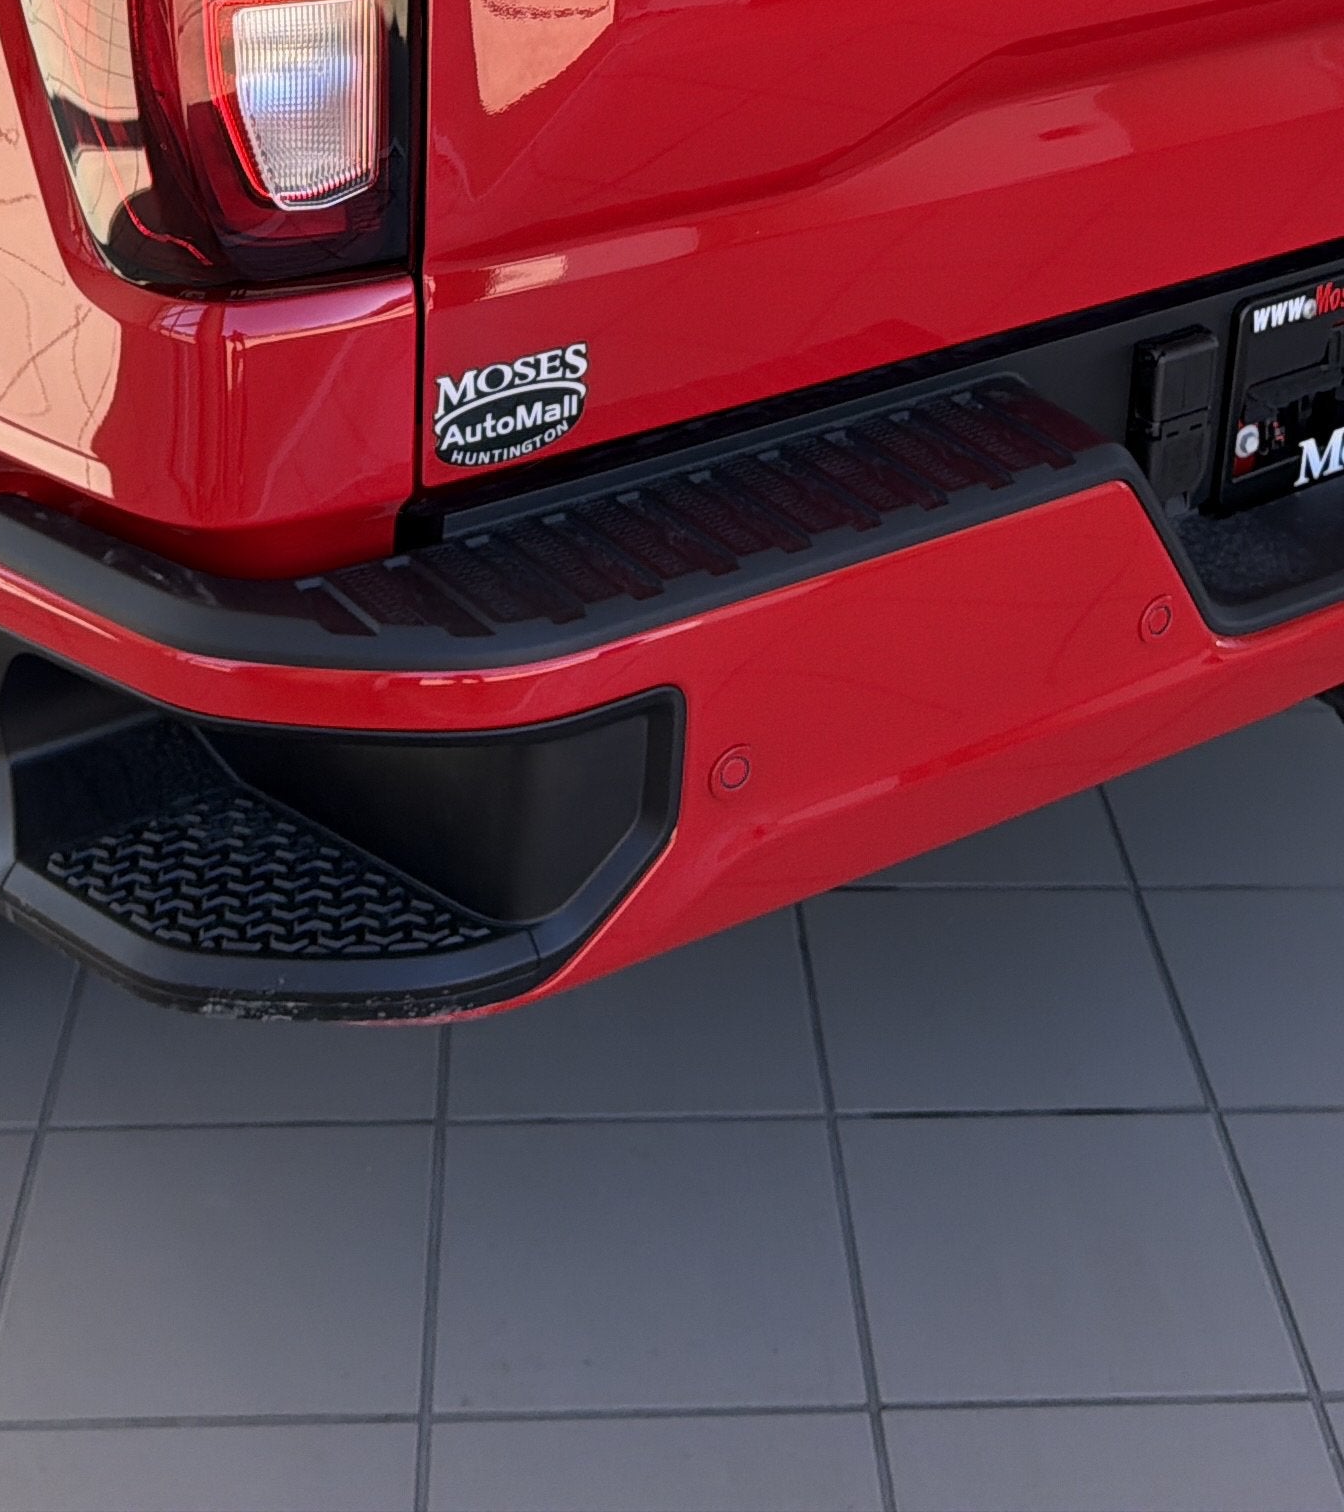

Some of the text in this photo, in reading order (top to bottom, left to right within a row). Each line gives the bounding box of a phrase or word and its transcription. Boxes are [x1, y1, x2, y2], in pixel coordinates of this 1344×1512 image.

[434, 343, 588, 420] MOSES
[440, 394, 579, 451] AutoMall
[451, 420, 569, 465] HUNTINGTON
